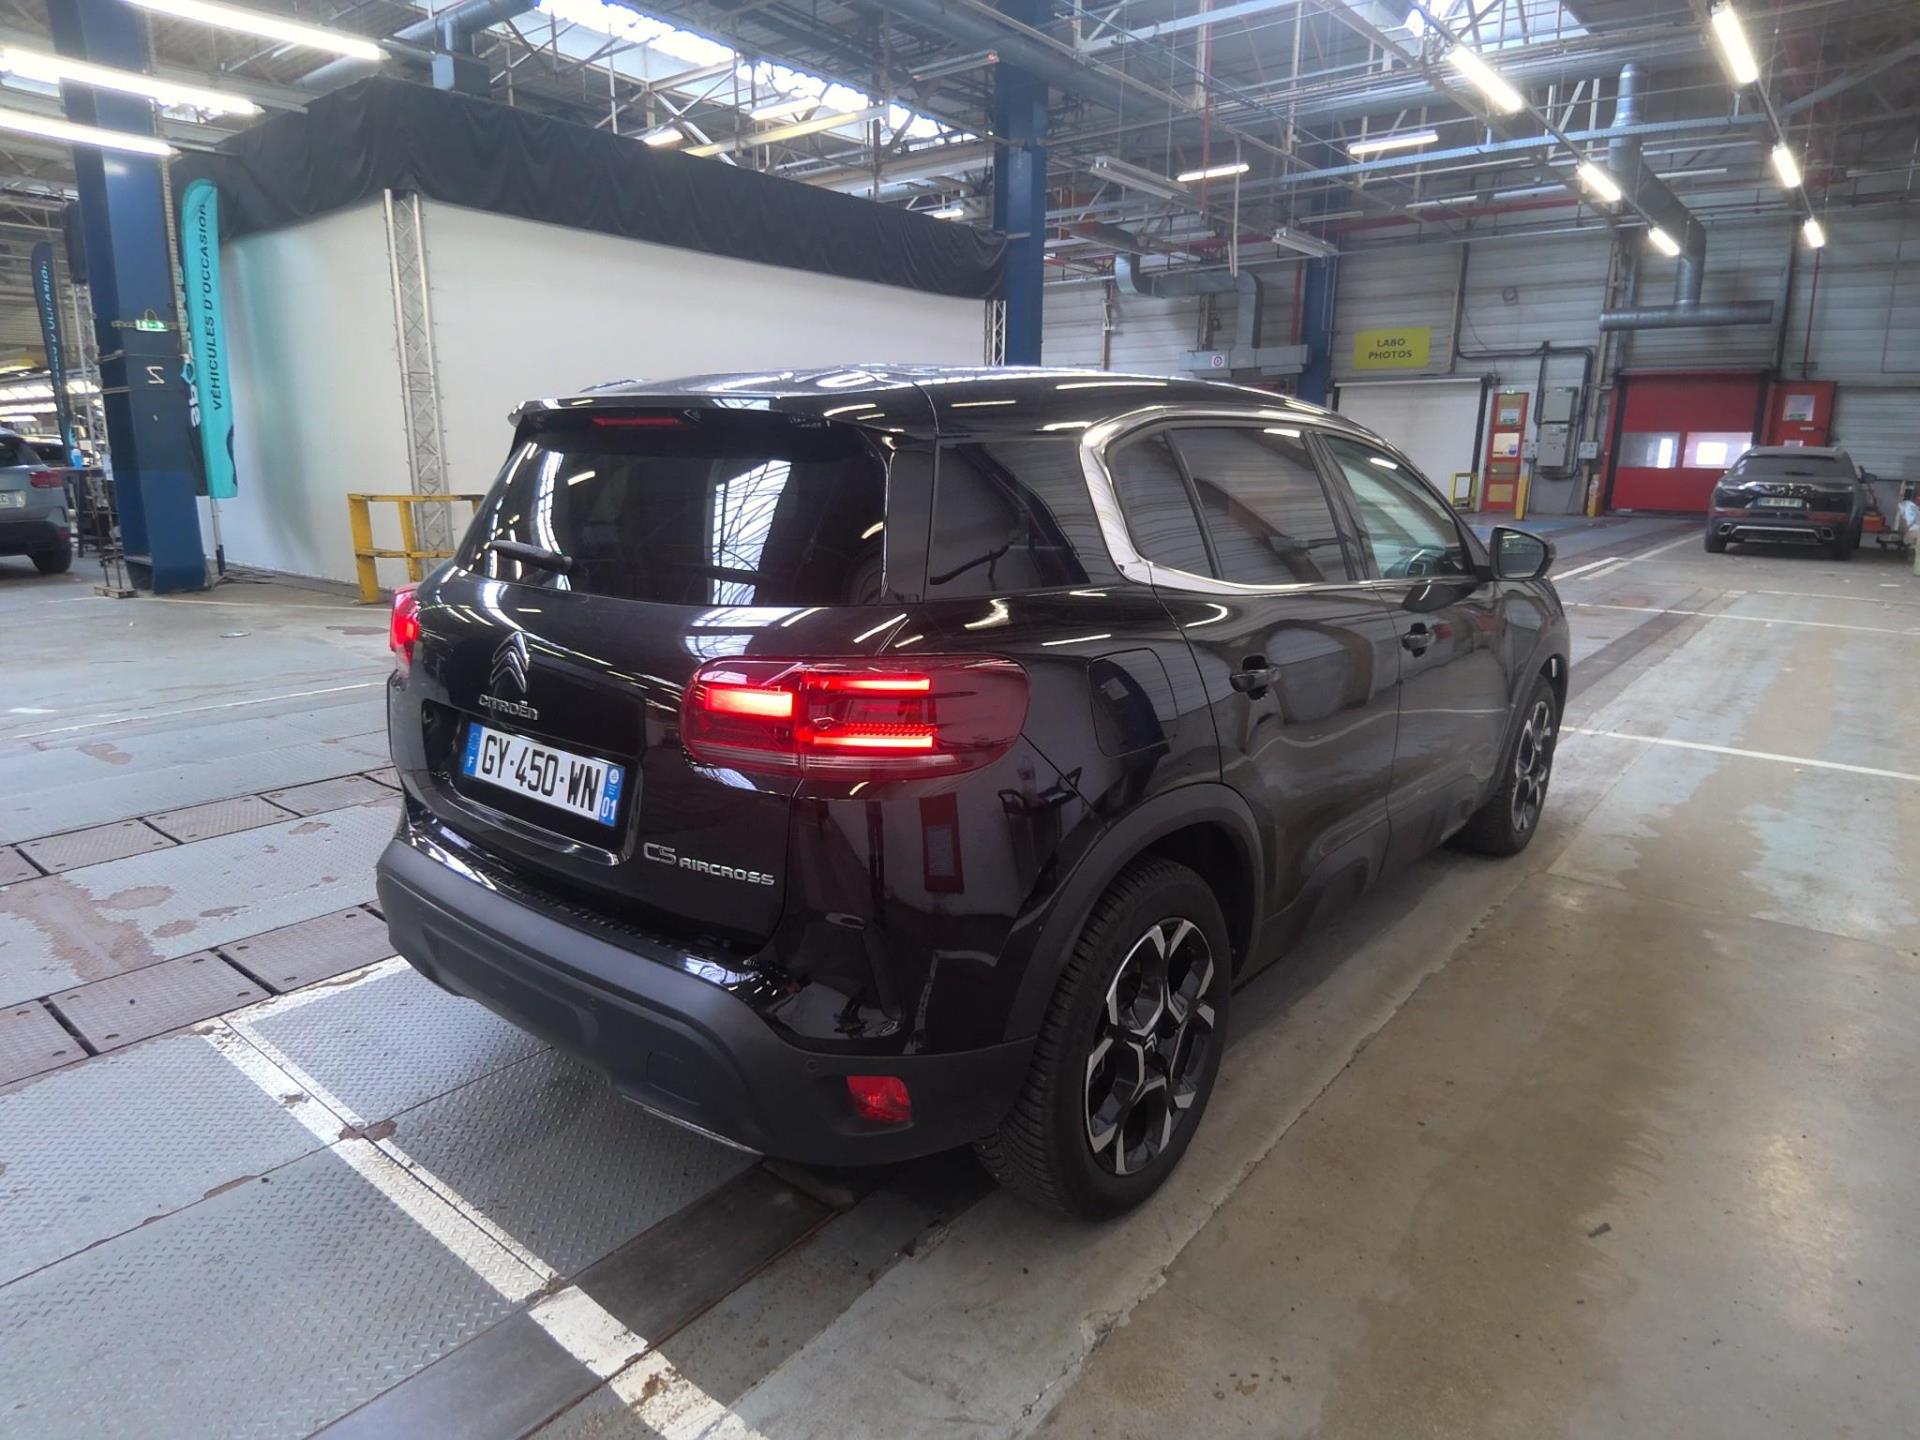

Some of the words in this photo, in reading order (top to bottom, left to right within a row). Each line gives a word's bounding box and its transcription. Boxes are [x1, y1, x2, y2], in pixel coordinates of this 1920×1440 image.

[1368, 350, 1413, 360] PHOTOS
[1377, 338, 1406, 348] LABO
[203, 315, 222, 411] VÉHICULES
[478, 694, 540, 721] CITROËN
[466, 756, 474, 768] F
[601, 796, 617, 821] 01
[643, 842, 677, 865] C5
[679, 857, 776, 886] AIRCROSS
